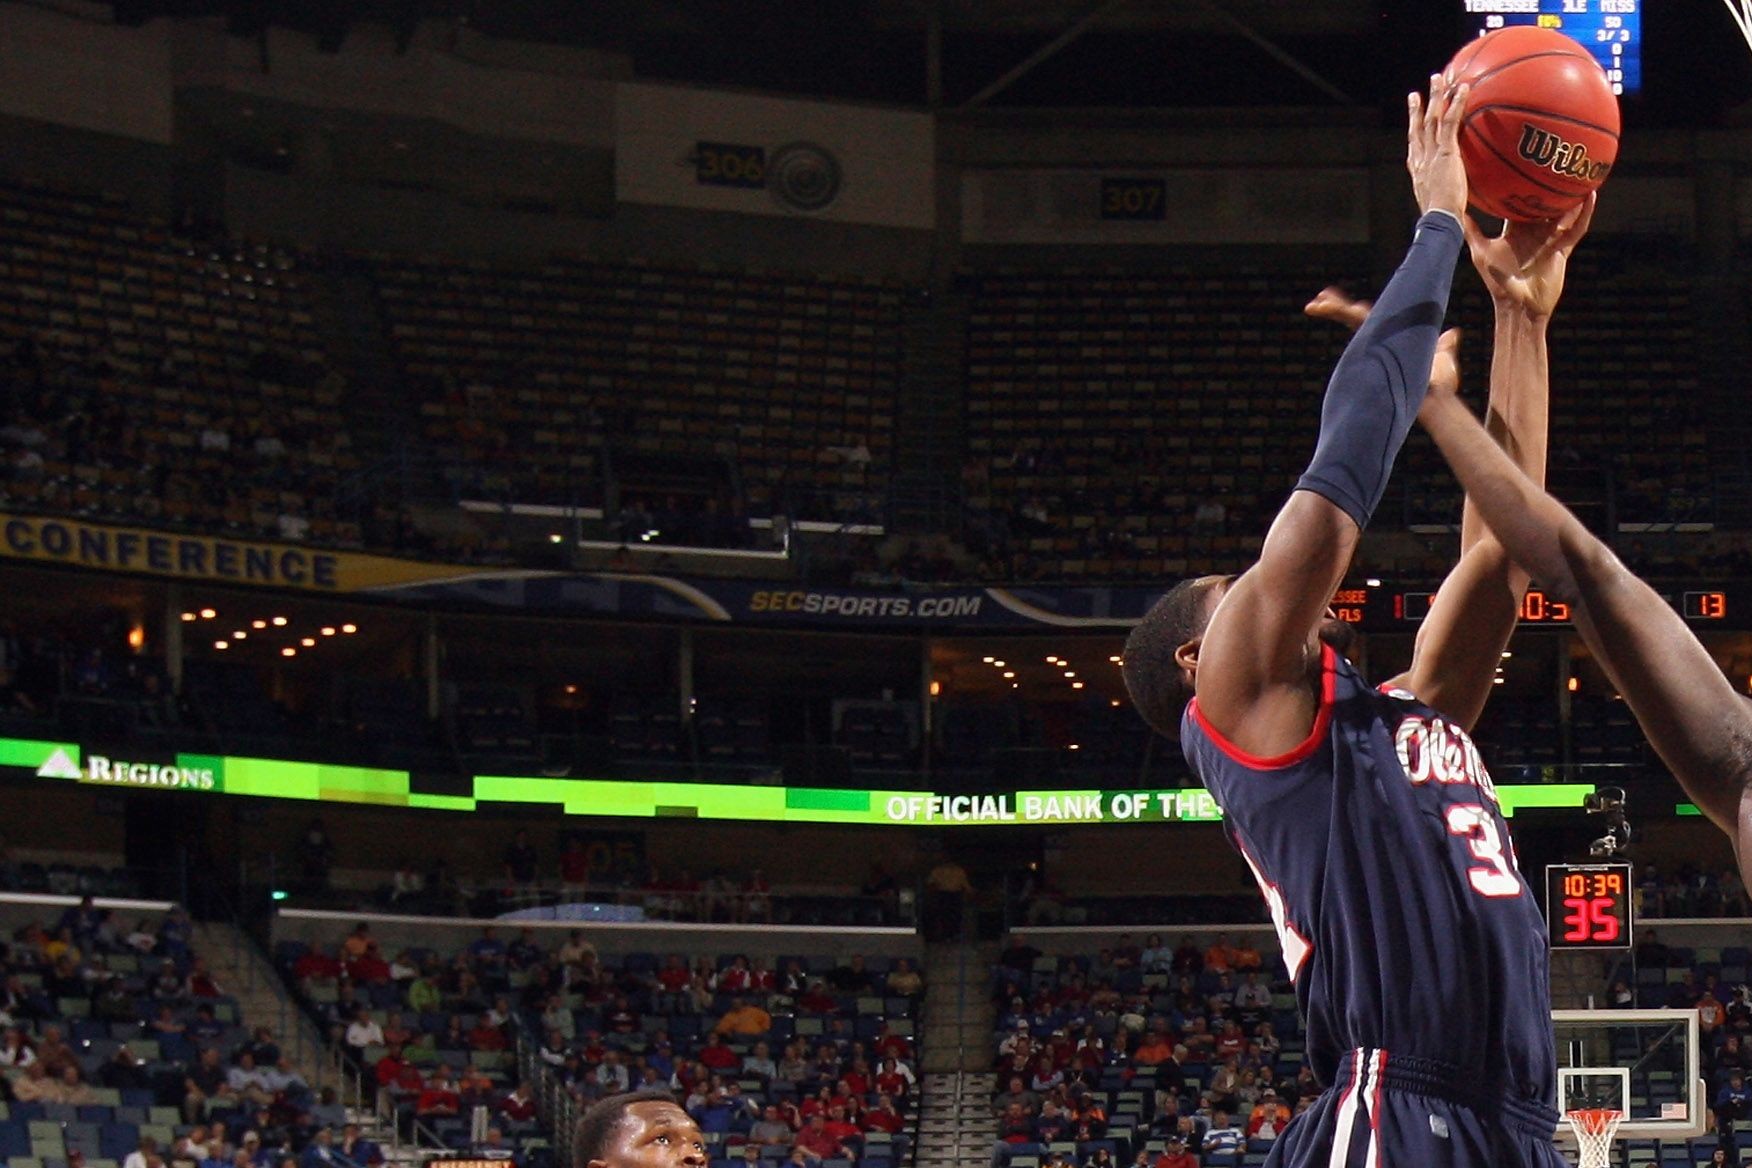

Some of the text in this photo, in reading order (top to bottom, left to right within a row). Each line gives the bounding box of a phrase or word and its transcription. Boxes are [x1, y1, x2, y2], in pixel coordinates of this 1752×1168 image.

[702, 153, 764, 180] 306
[1103, 186, 1163, 214] 307
[5, 518, 337, 586] CONFERENCE
[749, 588, 982, 619] SECSPORTS.COM
[1701, 594, 1724, 617] 13
[887, 792, 1215, 821] OFFICIAL BANK OF THE
[1564, 873, 1620, 897] 10:39
[1563, 898, 1619, 941] 35
